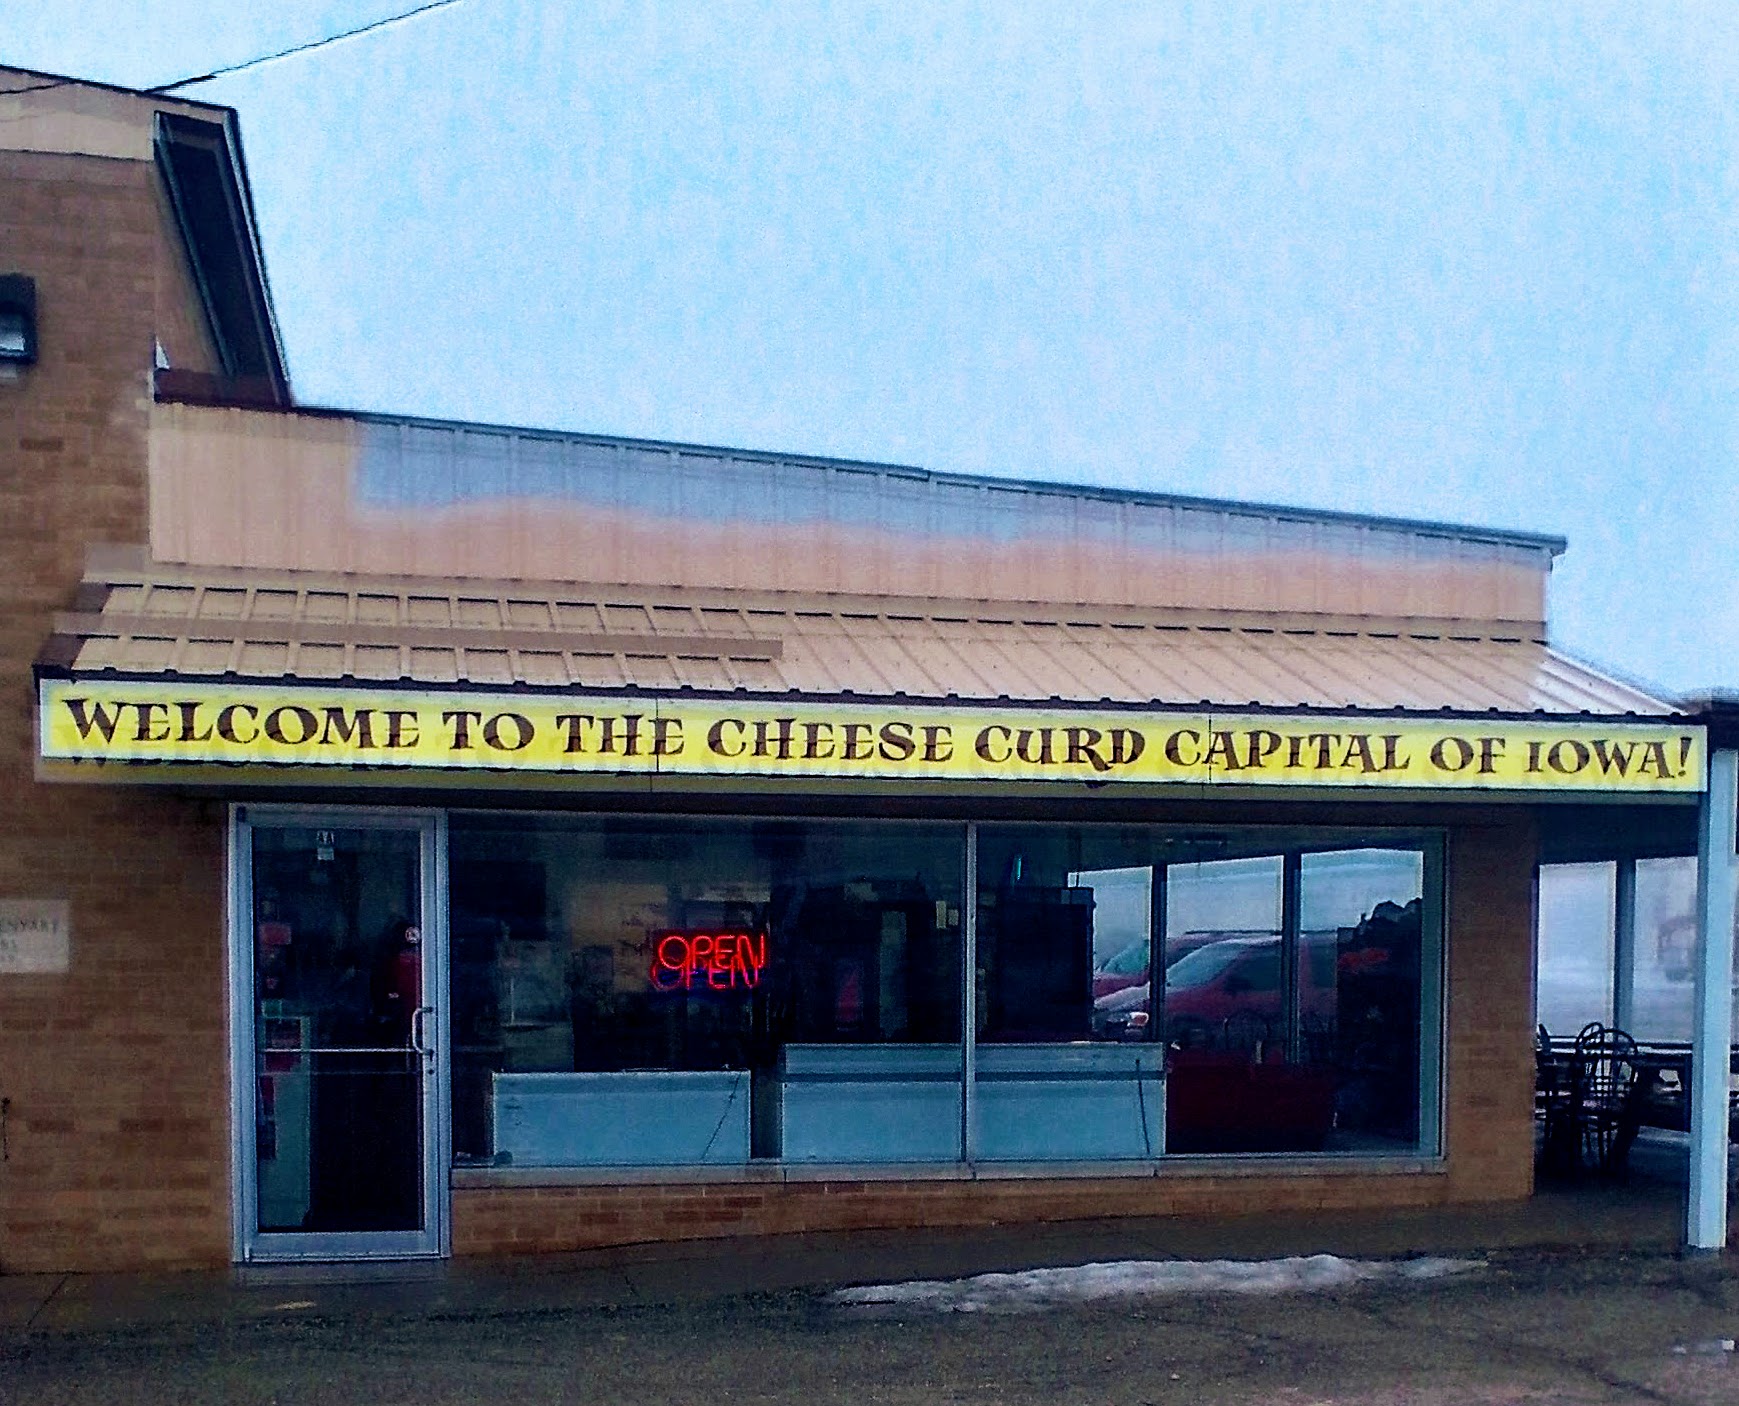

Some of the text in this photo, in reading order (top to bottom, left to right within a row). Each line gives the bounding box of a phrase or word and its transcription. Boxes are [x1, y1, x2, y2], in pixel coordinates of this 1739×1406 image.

[64, 698, 1692, 779] WELCOME TO THE CHEESE CURD CAPITAL OF IOWA!
[658, 933, 766, 970] OPEN
